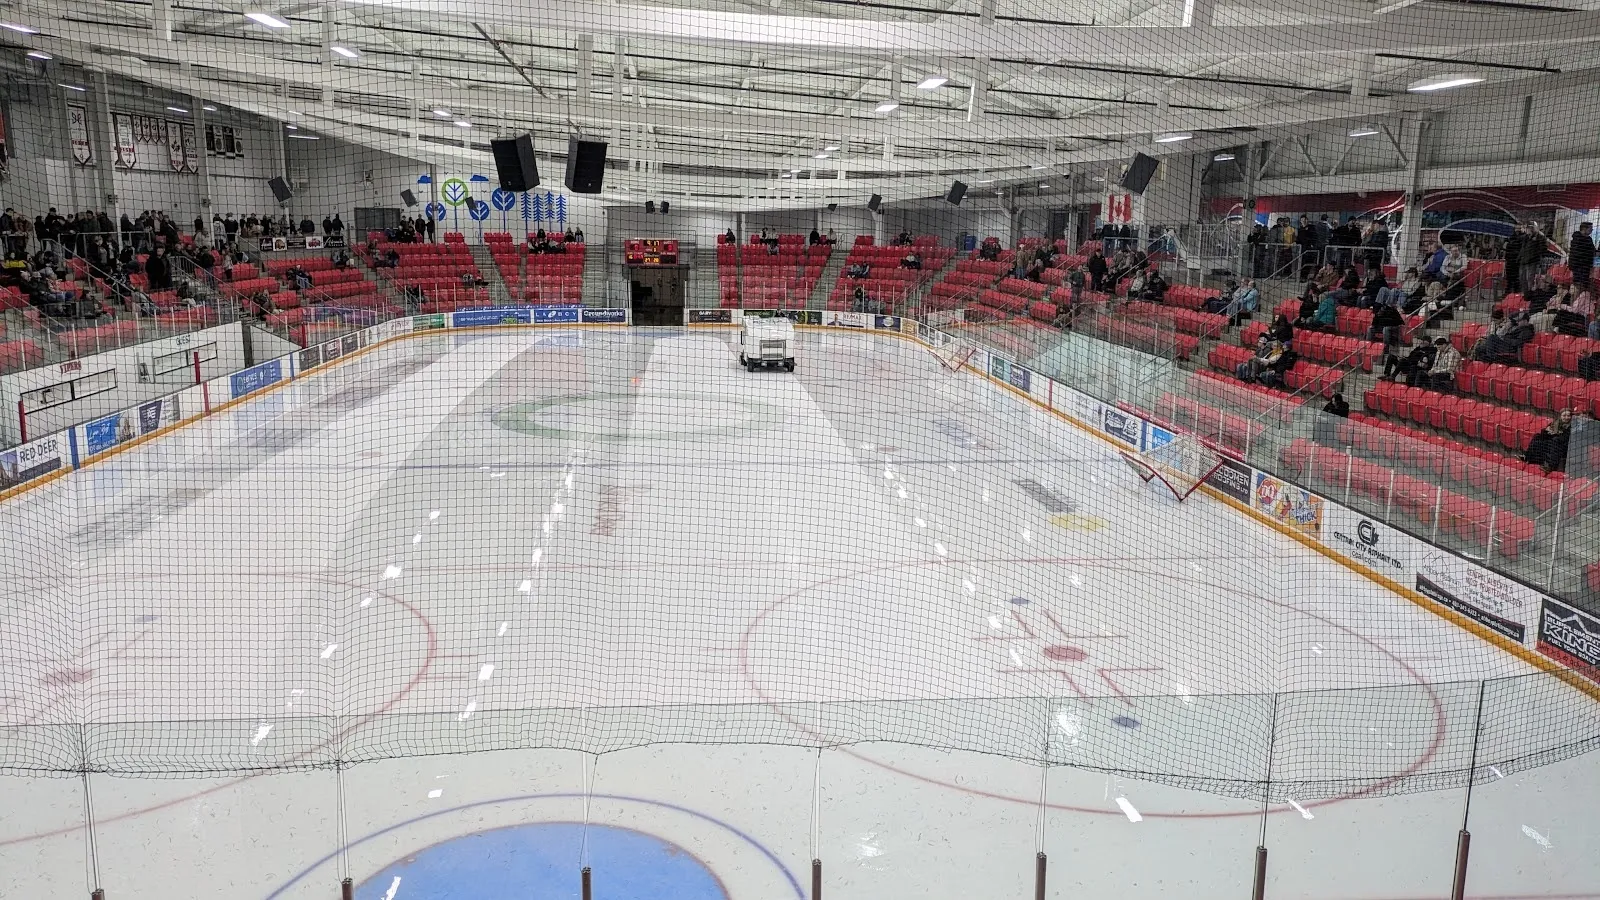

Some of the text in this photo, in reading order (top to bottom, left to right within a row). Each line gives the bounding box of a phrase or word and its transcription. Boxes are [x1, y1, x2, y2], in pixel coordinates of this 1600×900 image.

[175, 334, 191, 346] GUEST
[60, 360, 82, 374] VIPERS
[20, 439, 58, 463] RED DEER
[1355, 541, 1367, 552] CITY
[1547, 636, 1562, 648] FUEL
